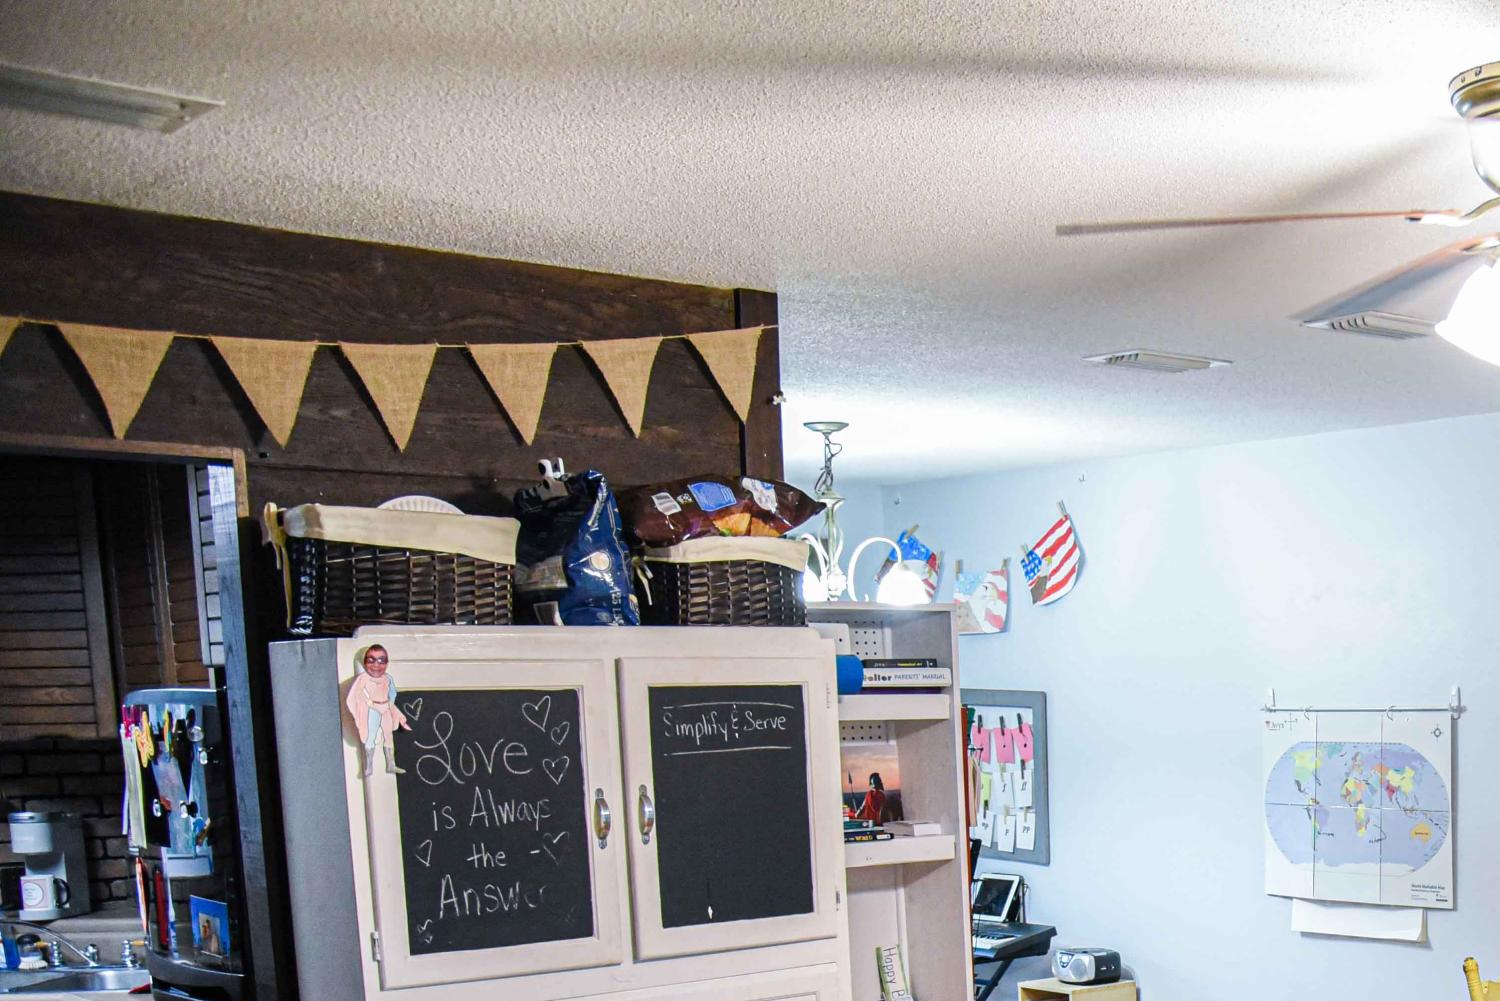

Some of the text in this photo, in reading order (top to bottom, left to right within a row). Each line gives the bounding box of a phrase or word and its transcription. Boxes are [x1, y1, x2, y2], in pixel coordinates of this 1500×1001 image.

[663, 710, 728, 746] Simplify
[743, 710, 787, 732] Serve
[414, 711, 533, 785] Love
[432, 785, 551, 832] is Always
[466, 842, 507, 869] the
[883, 946, 897, 985] Happy
